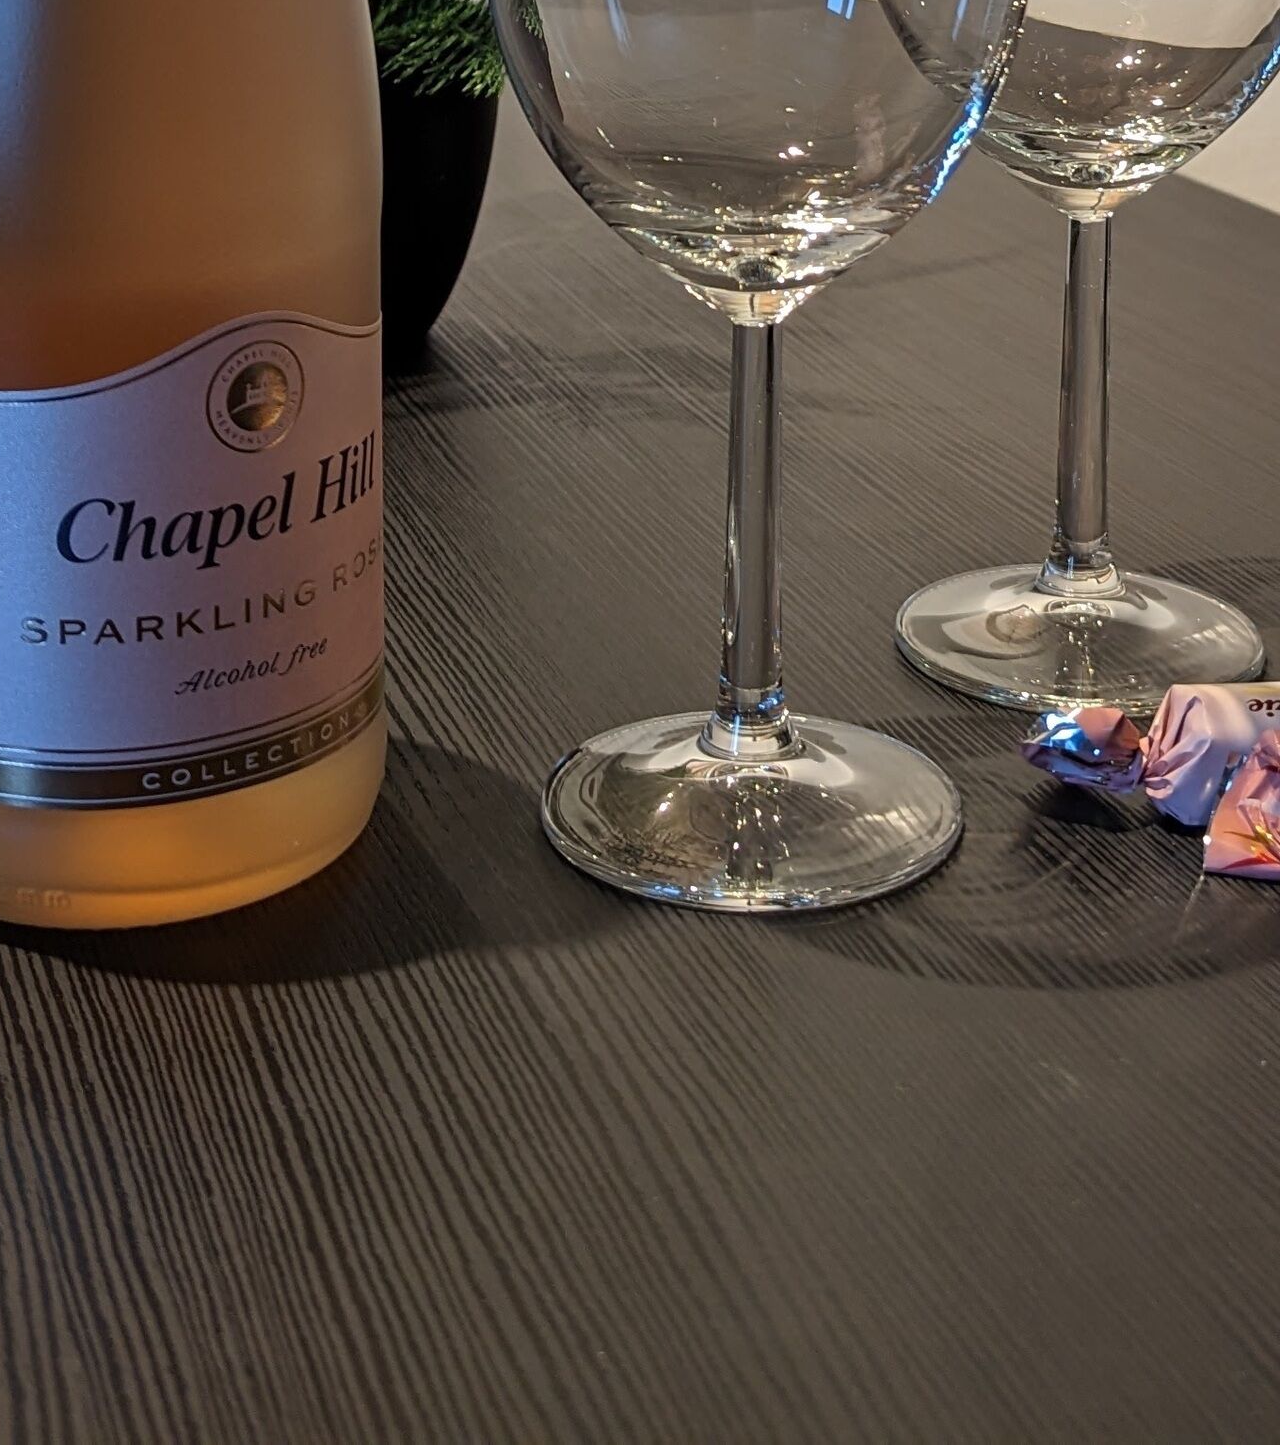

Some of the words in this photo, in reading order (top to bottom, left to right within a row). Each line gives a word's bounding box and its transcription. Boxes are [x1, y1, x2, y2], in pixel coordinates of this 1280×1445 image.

[56, 471, 296, 570] Chapel
[310, 429, 375, 524] Hill
[21, 579, 317, 645] SPARKLING
[332, 529, 382, 592] ROS
[174, 652, 281, 695] Alcohol
[278, 638, 328, 675] free
[142, 712, 350, 791] COLLECTION
